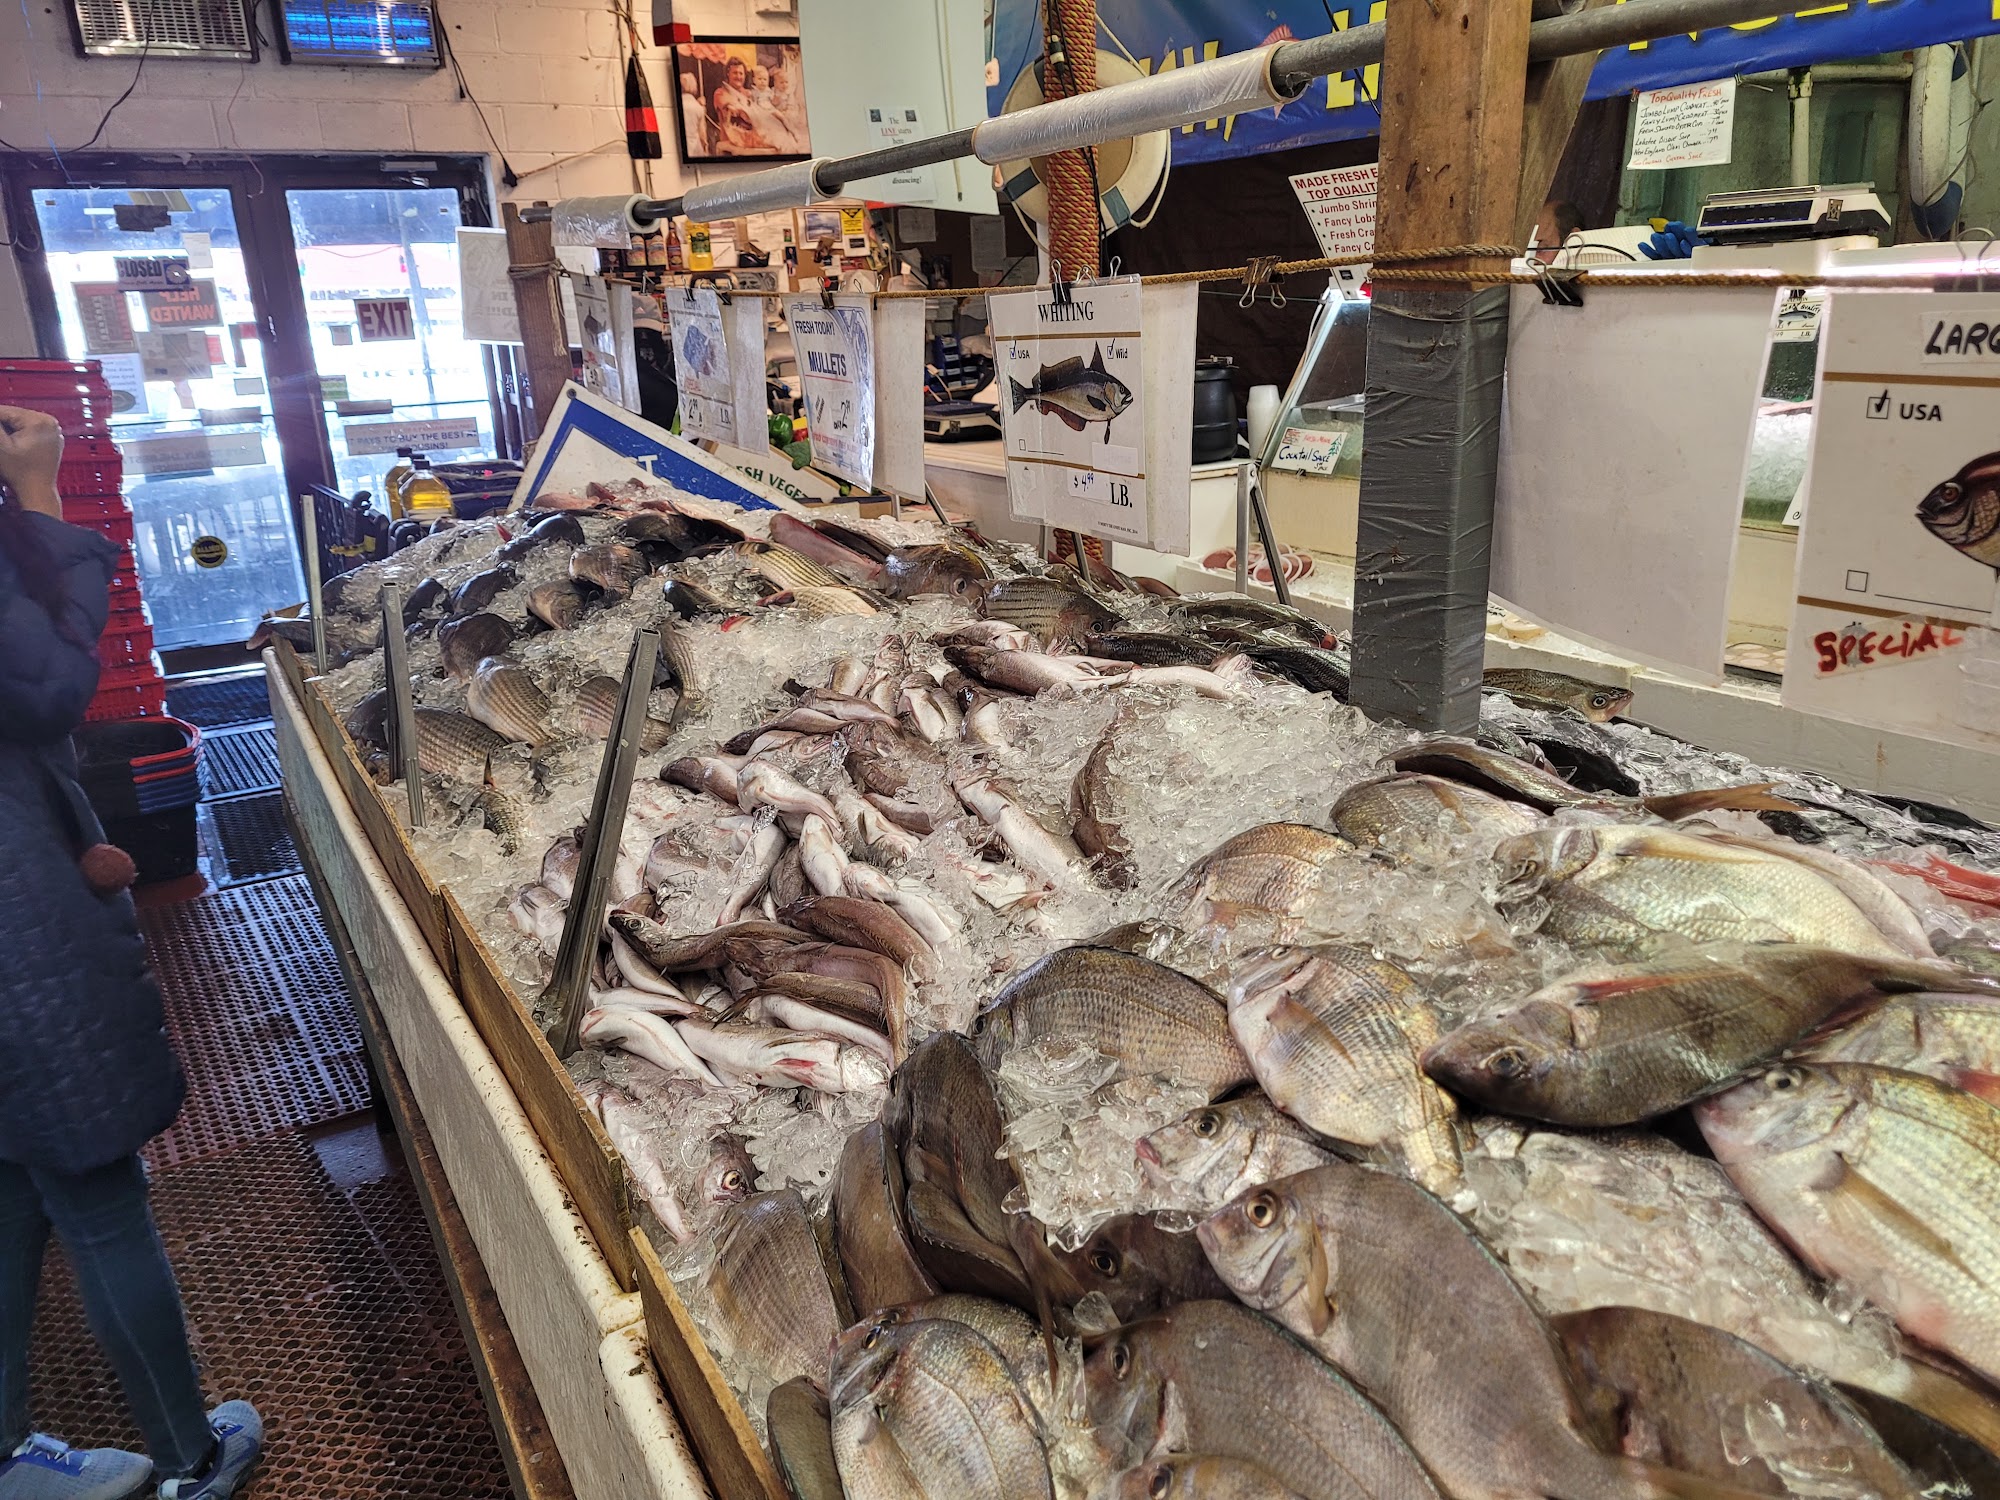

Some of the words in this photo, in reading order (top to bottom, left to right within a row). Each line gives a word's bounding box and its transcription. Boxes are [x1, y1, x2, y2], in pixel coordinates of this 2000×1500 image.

[1294, 175, 1331, 190] MADE
[1331, 169, 1370, 184] FRESH
[1306, 188, 1331, 201] TOP
[1333, 181, 1378, 197] QUALIT
[1319, 202, 1350, 214] Jumbo
[1324, 217, 1352, 227] Fancy
[1330, 229, 1356, 240] Fresh
[1334, 244, 1361, 254] Fancy
[117, 259, 163, 278] CLOSED
[357, 301, 409, 337] EXIT
[1038, 301, 1094, 322] WHITING
[794, 320, 814, 335] FRESH
[814, 320, 835, 336] TODAY!
[1018, 349, 1031, 359] USA
[1115, 348, 1128, 359] Wild
[807, 351, 848, 377] MULLETS
[1900, 403, 1943, 422] USA
[420, 431, 439, 441] THE
[441, 430, 464, 440] BEST
[1110, 481, 1133, 508] LB.
